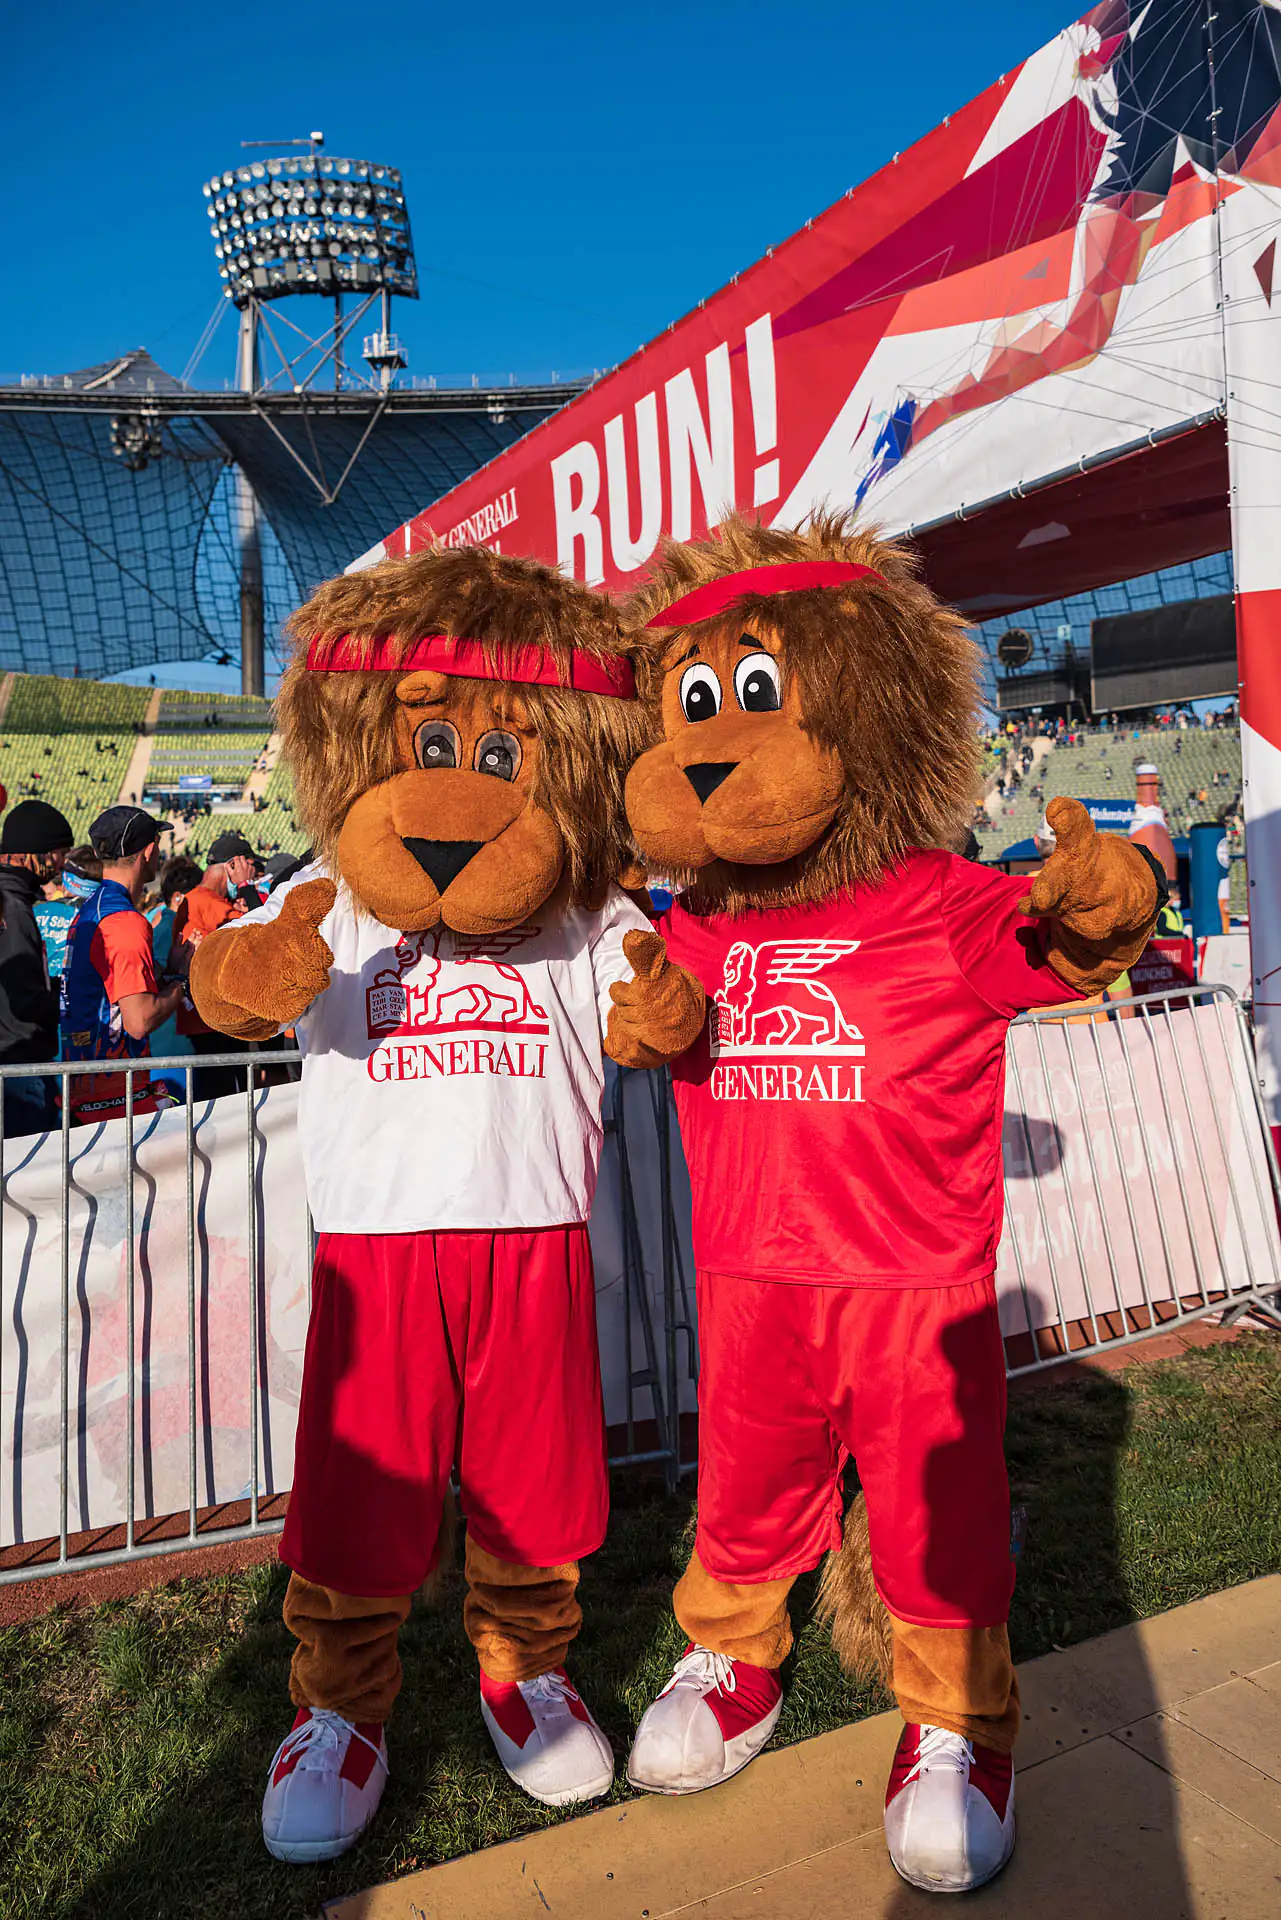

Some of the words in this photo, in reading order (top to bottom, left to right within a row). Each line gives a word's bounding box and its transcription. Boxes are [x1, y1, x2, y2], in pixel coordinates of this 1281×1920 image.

[551, 312, 780, 588] RUN!
[448, 487, 519, 549] GENERALI
[367, 1039, 549, 1083] GENERALI
[710, 1064, 866, 1103] GENERALI
